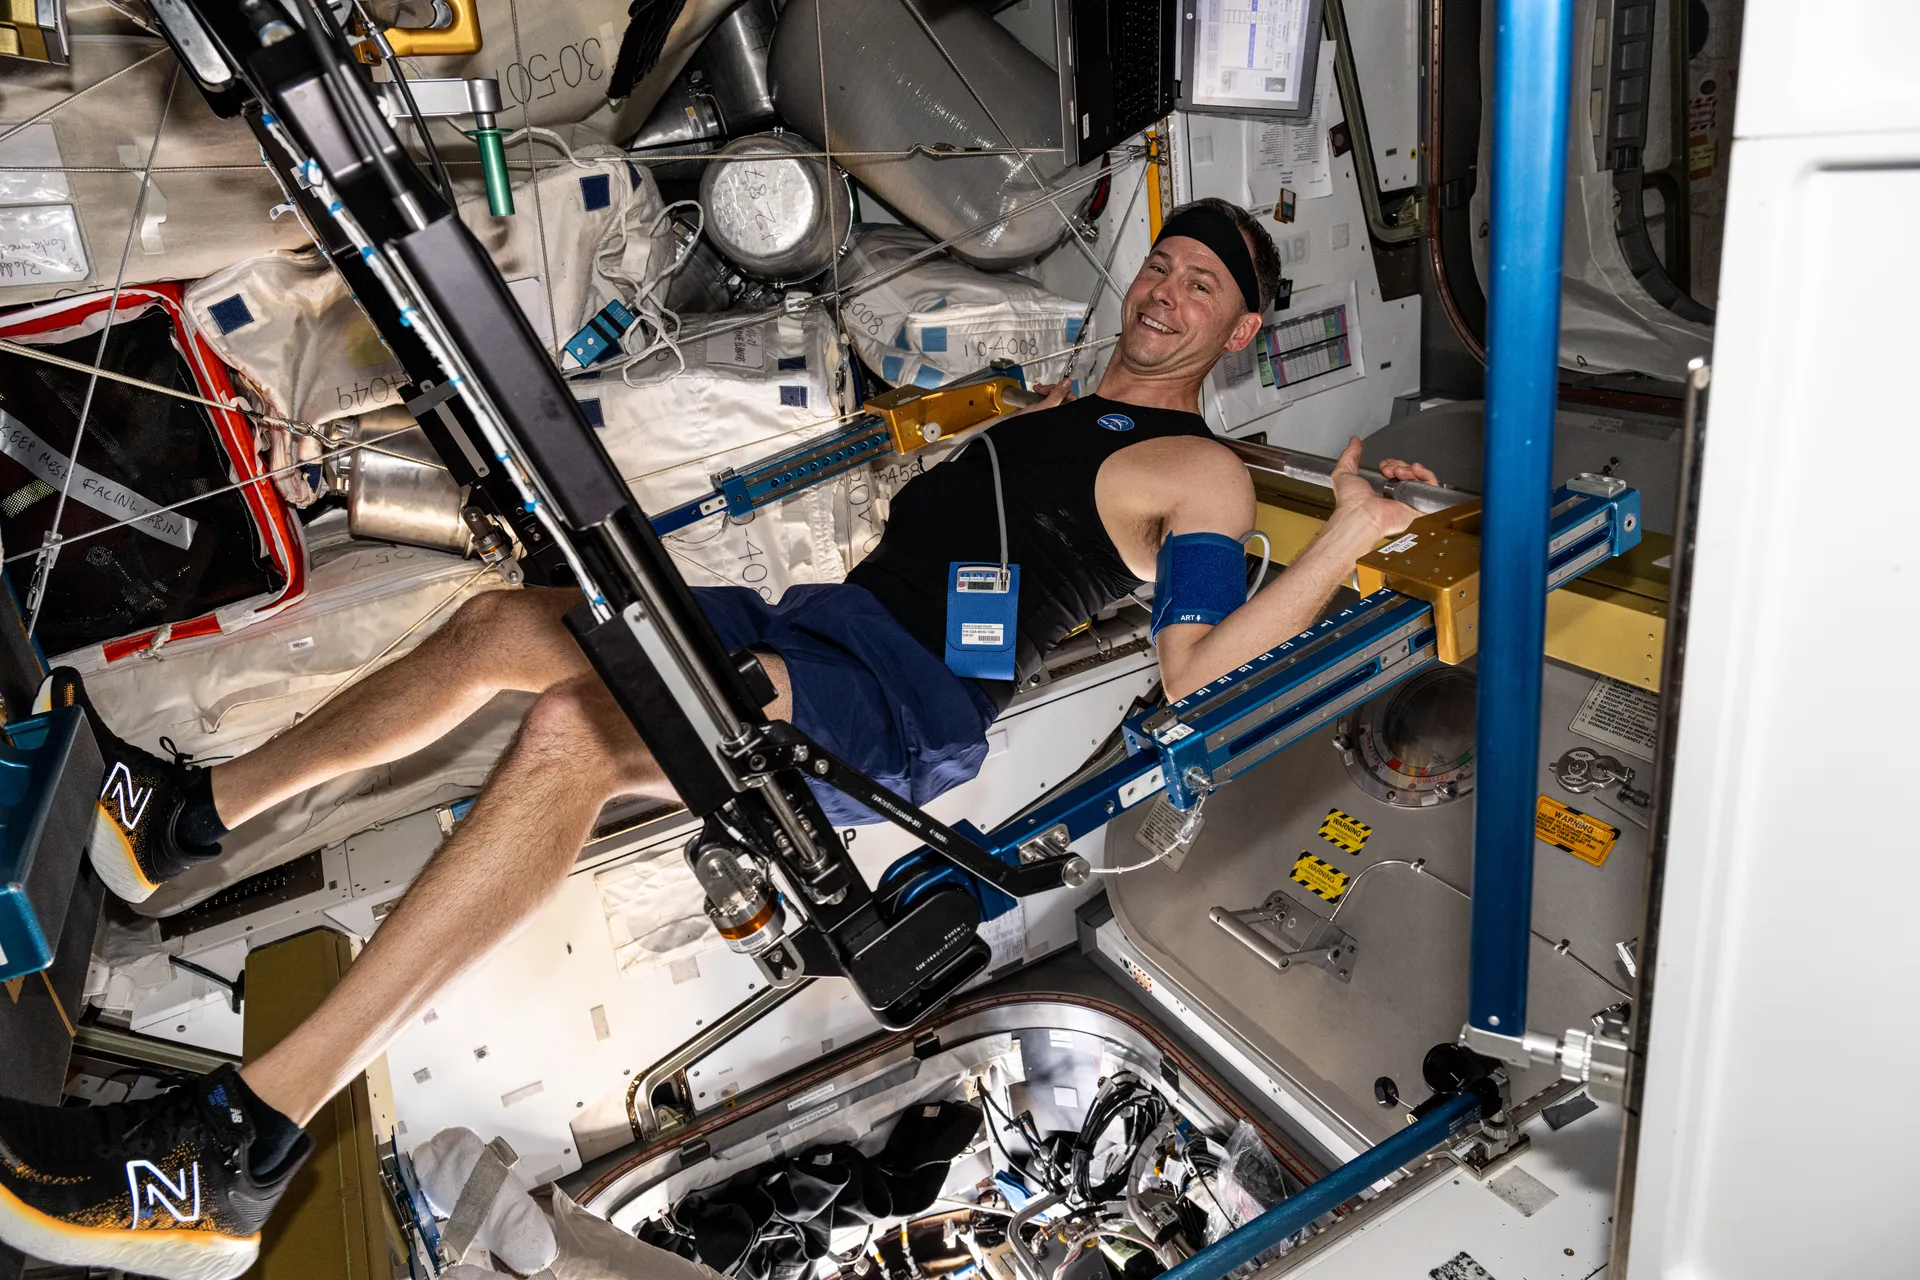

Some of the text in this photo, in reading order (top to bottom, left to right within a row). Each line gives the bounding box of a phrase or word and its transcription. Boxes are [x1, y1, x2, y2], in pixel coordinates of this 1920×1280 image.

[1411, 773, 1449, 785] EQUALIZE
[1332, 816, 1362, 838] WARNING
[1553, 809, 1594, 835] WARNING
[1306, 862, 1336, 883] WARNING
